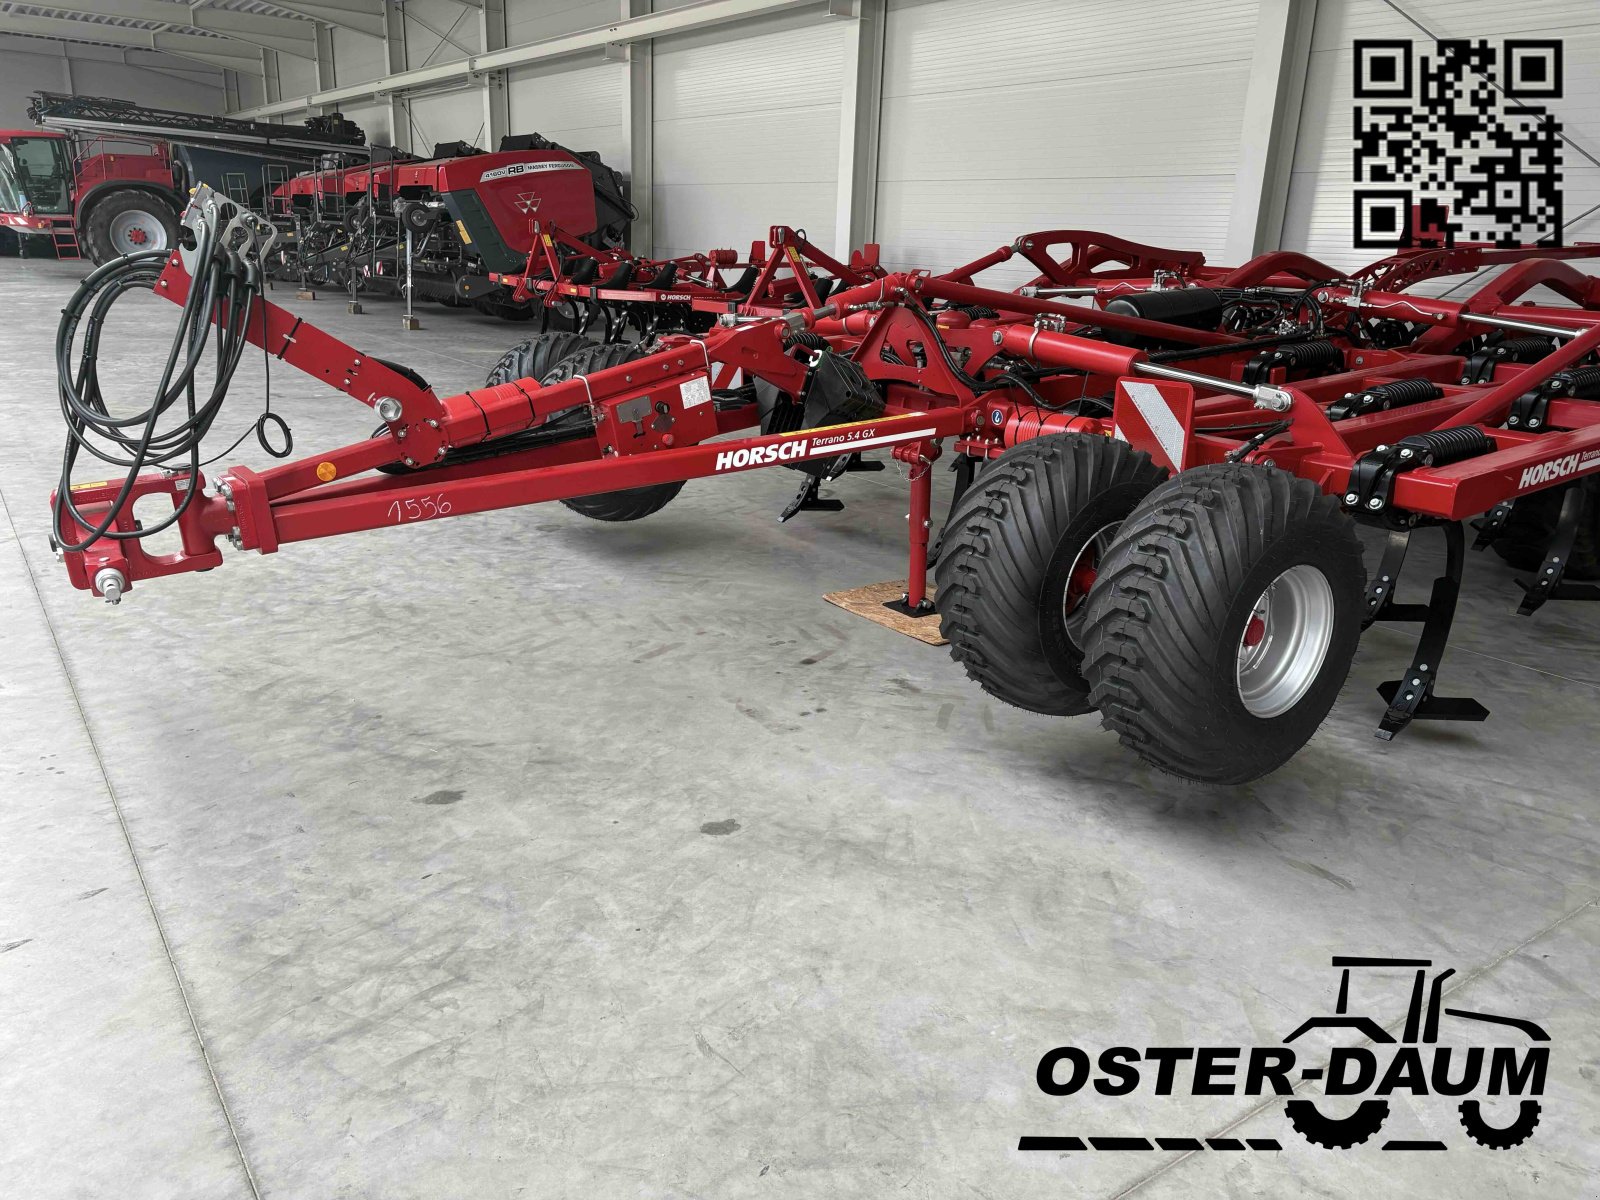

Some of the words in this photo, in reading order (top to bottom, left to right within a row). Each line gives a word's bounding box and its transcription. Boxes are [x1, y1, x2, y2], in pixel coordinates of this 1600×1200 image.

[508, 165, 524, 175] RB
[715, 440, 808, 471] HORSCH
[812, 435, 845, 447] Terrano
[847, 431, 860, 440] 5.4
[862, 428, 876, 438] GX
[1518, 453, 1580, 490] HORSCH
[387, 493, 452, 522] 1556
